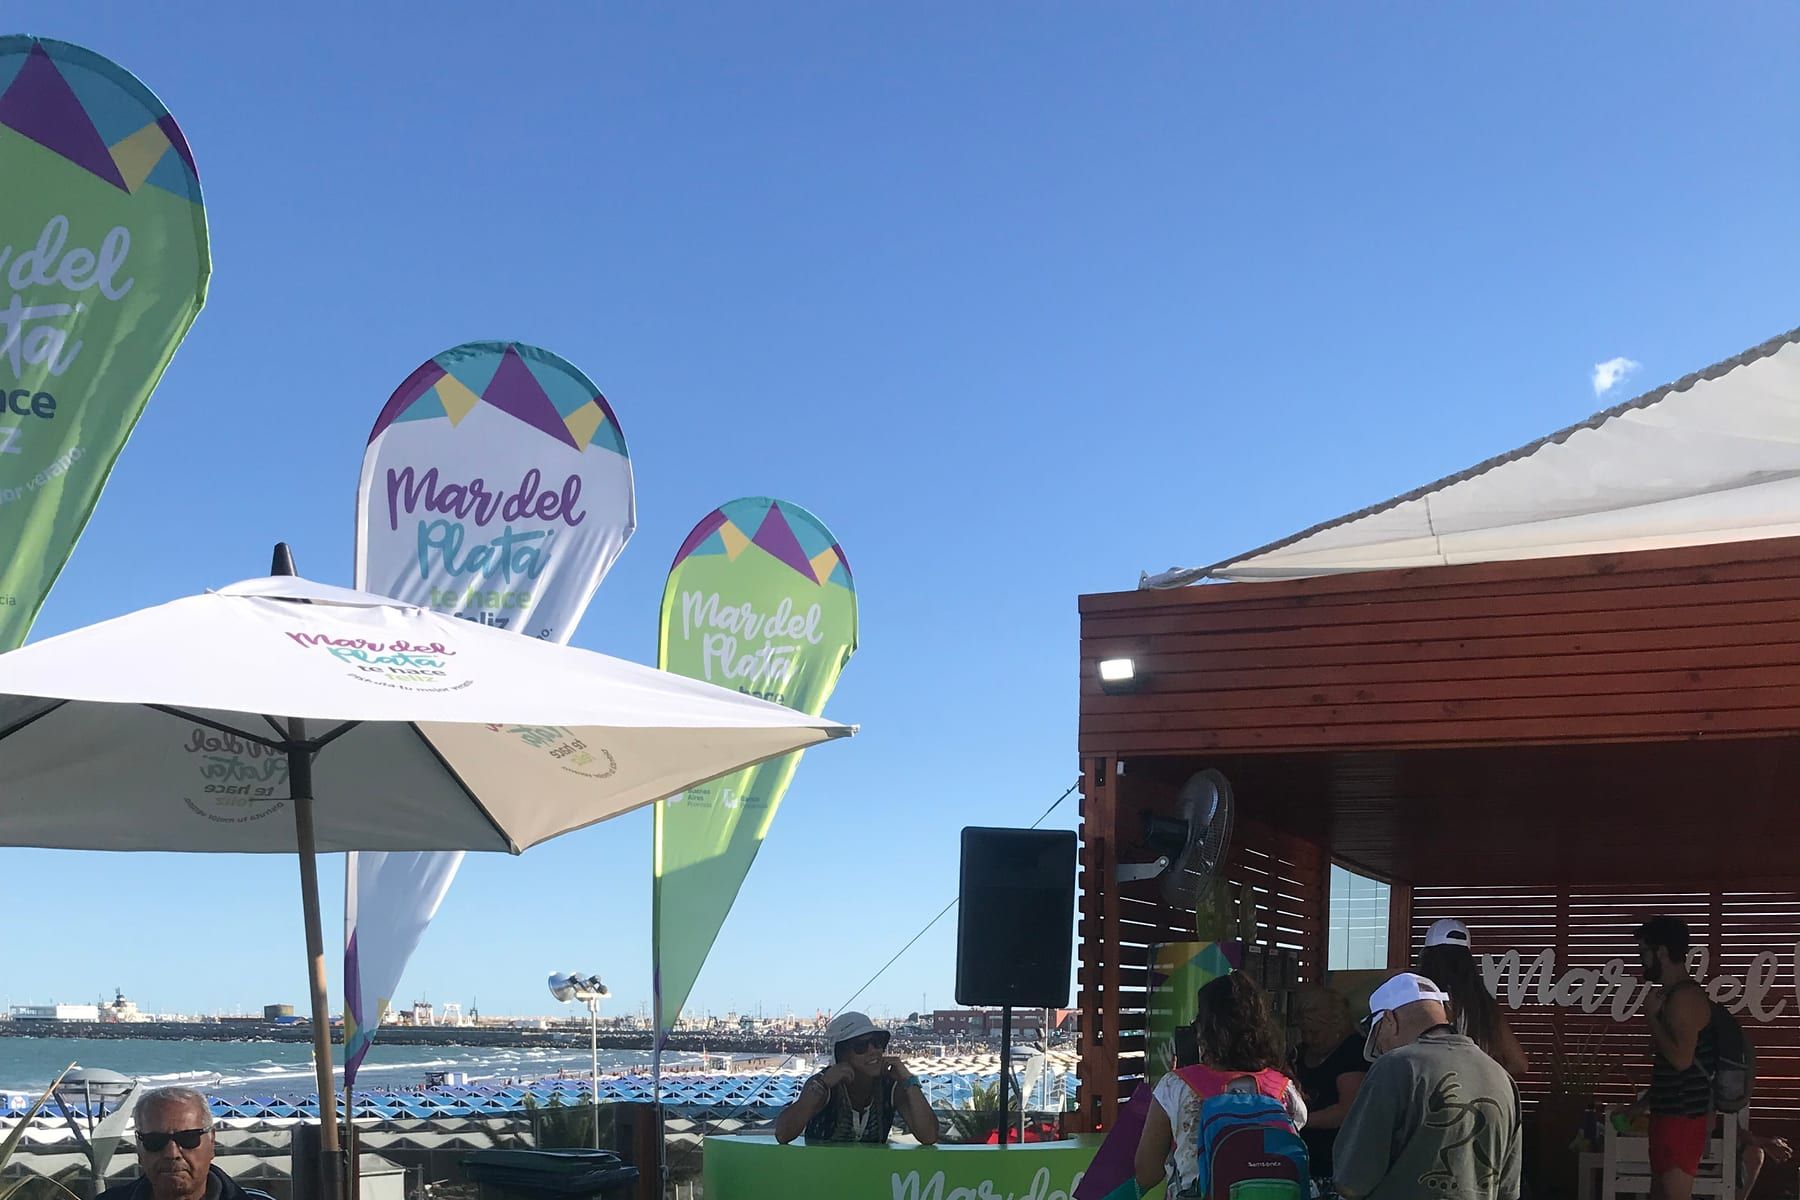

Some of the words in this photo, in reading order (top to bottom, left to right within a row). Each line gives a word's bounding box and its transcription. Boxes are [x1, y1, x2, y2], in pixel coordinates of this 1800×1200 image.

[7, 215, 134, 301] del
[387, 466, 503, 531] Mar
[502, 468, 587, 527] del
[417, 518, 555, 585] Plata
[430, 586, 458, 610] te
[464, 585, 533, 610] hace
[682, 590, 766, 641] Mar
[763, 597, 824, 645] del
[285, 631, 385, 653] Mar
[389, 639, 457, 656] del
[326, 646, 446, 669] Plata
[703, 632, 802, 681] Plata
[390, 666, 447, 677] hace
[1480, 947, 1652, 1022] Mar
